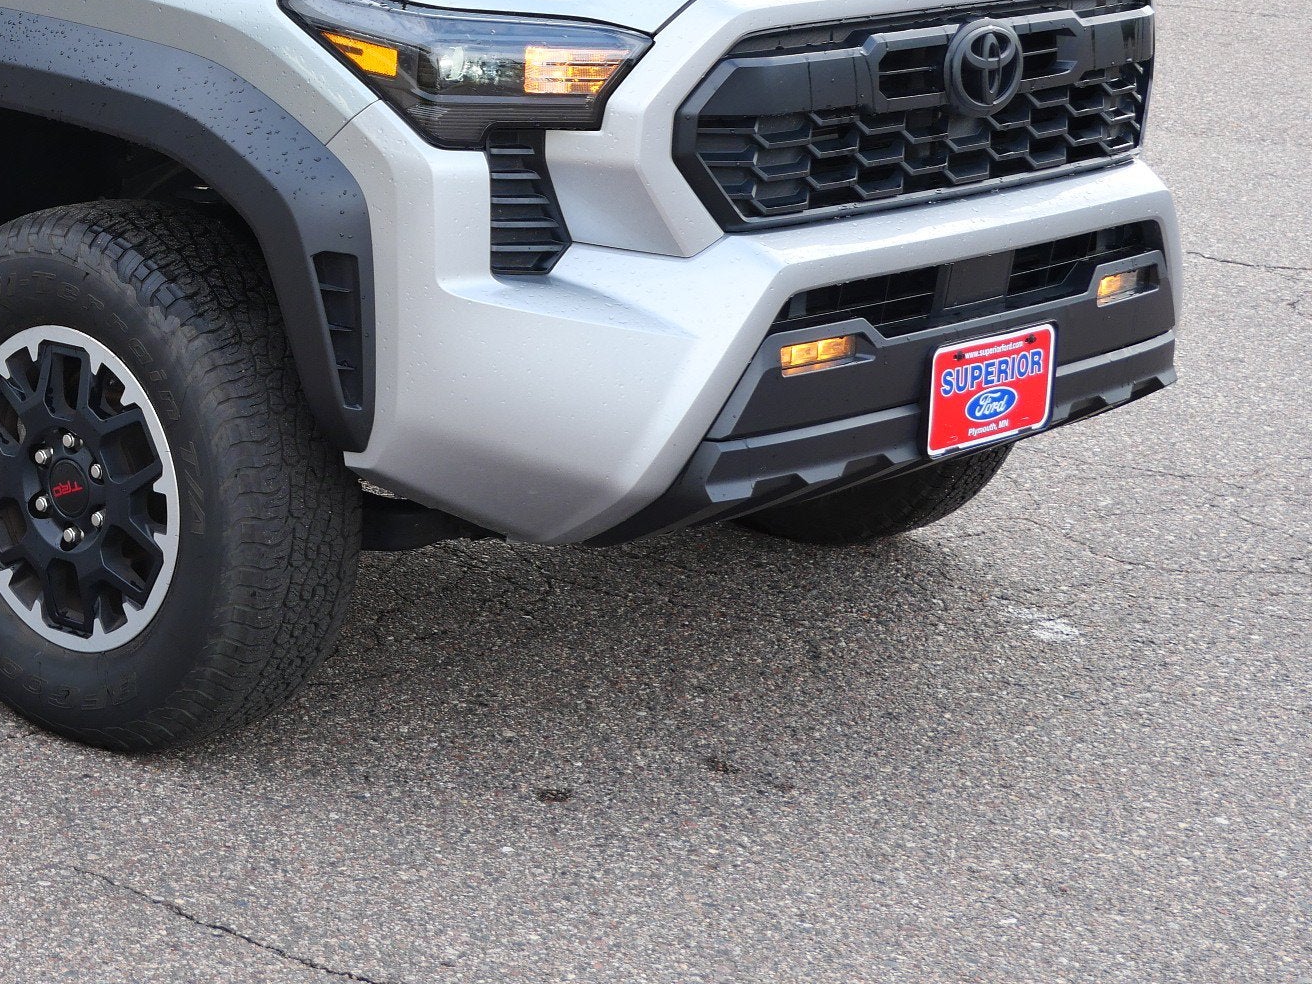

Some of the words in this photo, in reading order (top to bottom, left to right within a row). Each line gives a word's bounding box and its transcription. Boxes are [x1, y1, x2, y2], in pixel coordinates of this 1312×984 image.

[964, 341, 1024, 359] www.superiorford.com
[941, 348, 1044, 398] SUPERIOR
[975, 392, 1008, 417] Ford
[967, 423, 997, 437] Plymouth,
[998, 419, 1009, 429] MN
[52, 480, 83, 498] TRD
